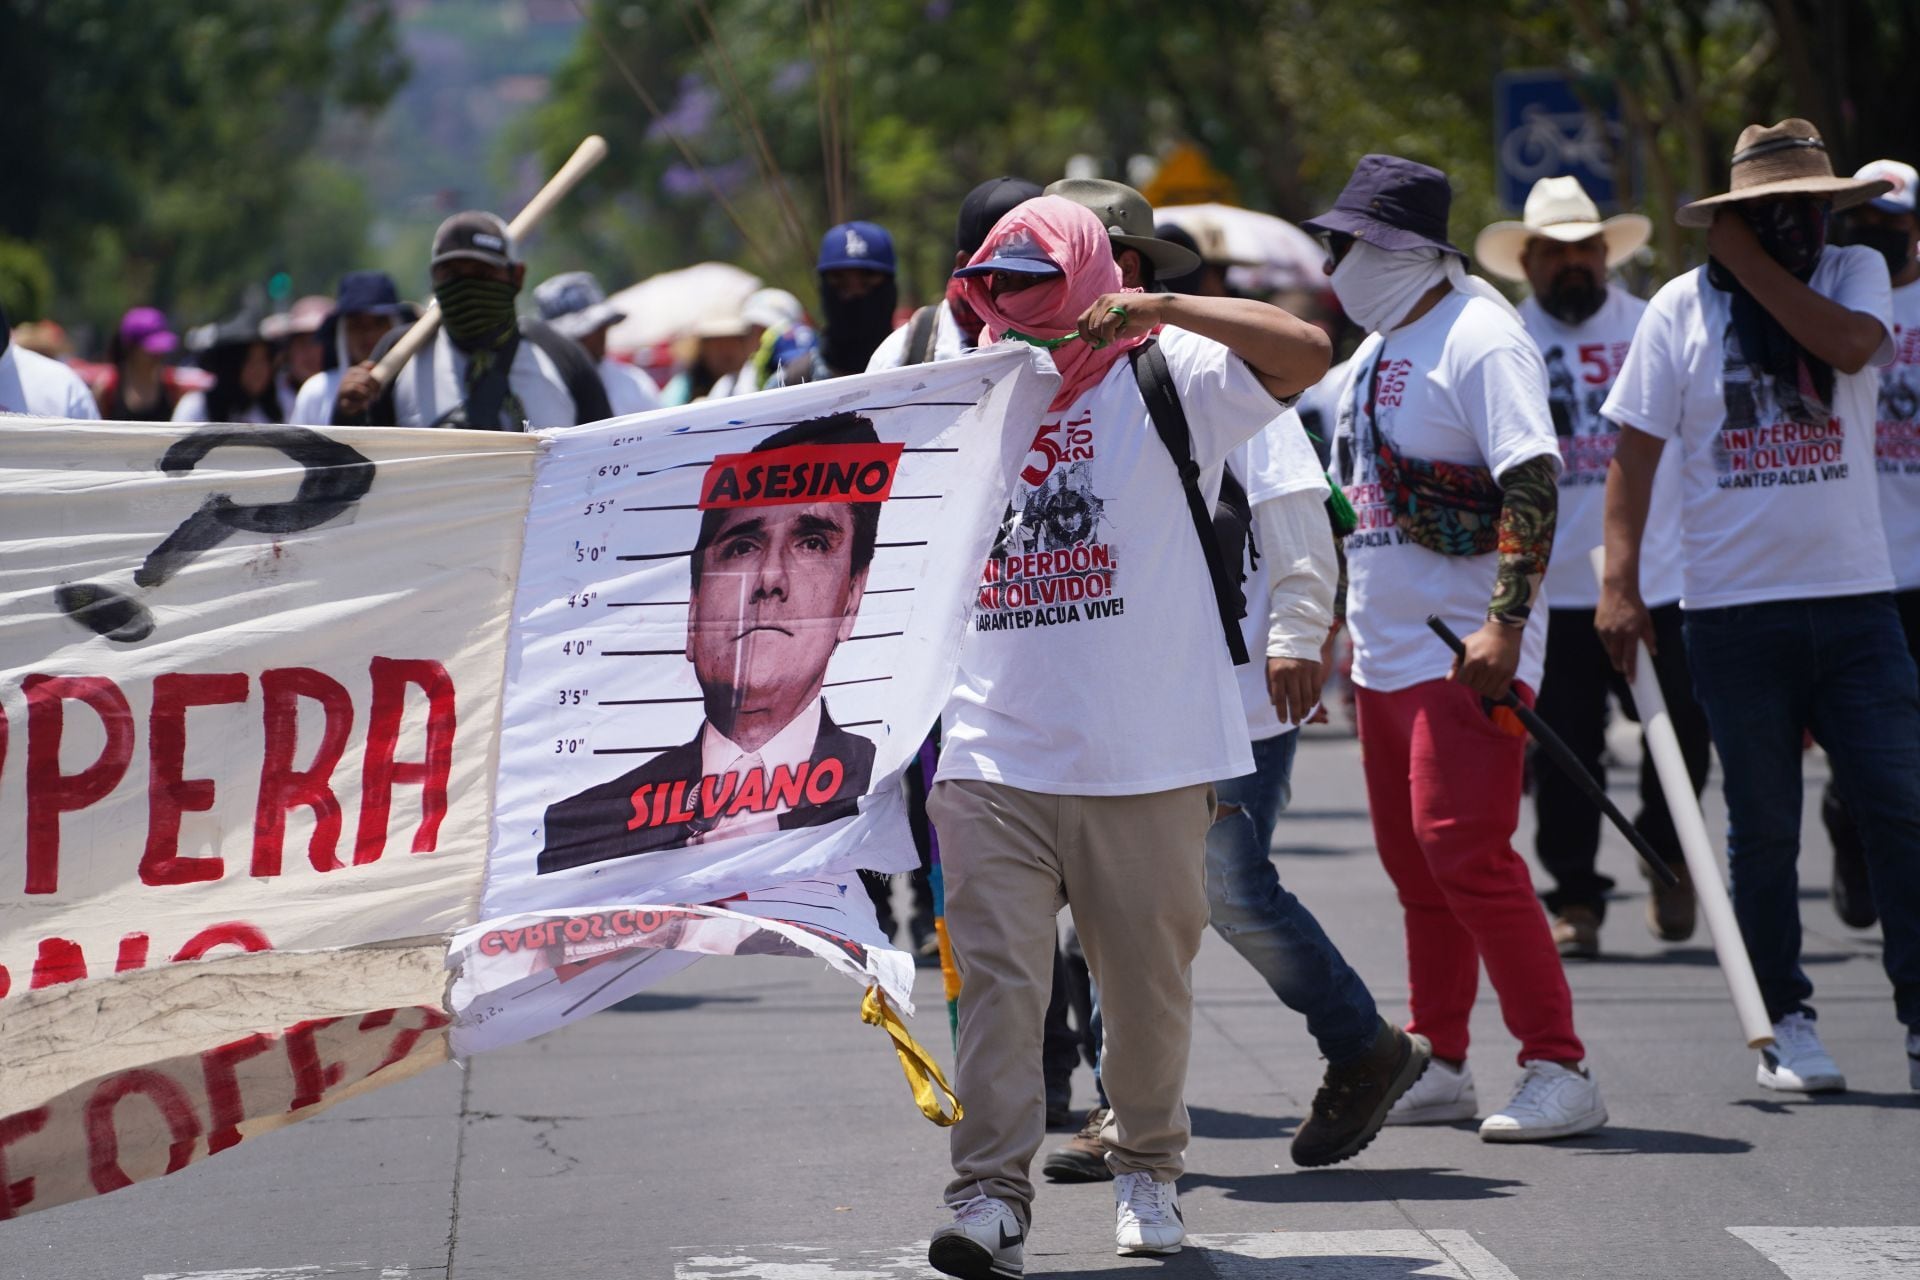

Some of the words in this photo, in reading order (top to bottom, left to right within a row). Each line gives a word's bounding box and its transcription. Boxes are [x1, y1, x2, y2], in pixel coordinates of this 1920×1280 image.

[598, 464, 629, 477] 6'0"
[1020, 419, 1062, 487] 5
[1754, 442, 1842, 469] OLVIDO!
[706, 460, 890, 502] ASESINO
[576, 546, 607, 562] 5'0"
[1005, 539, 1117, 580] PERDÓN,
[1005, 571, 1112, 609] OLVIDO!
[976, 604, 1081, 632] ¡ARANTEPACUA
[1084, 597, 1124, 620] VIVE!
[562, 640, 592, 655] 4'0"
[559, 689, 589, 705] 3'5"
[555, 738, 585, 753] 3'0"
[0, 656, 457, 894] PERA
[627, 757, 844, 831] SILVANO
